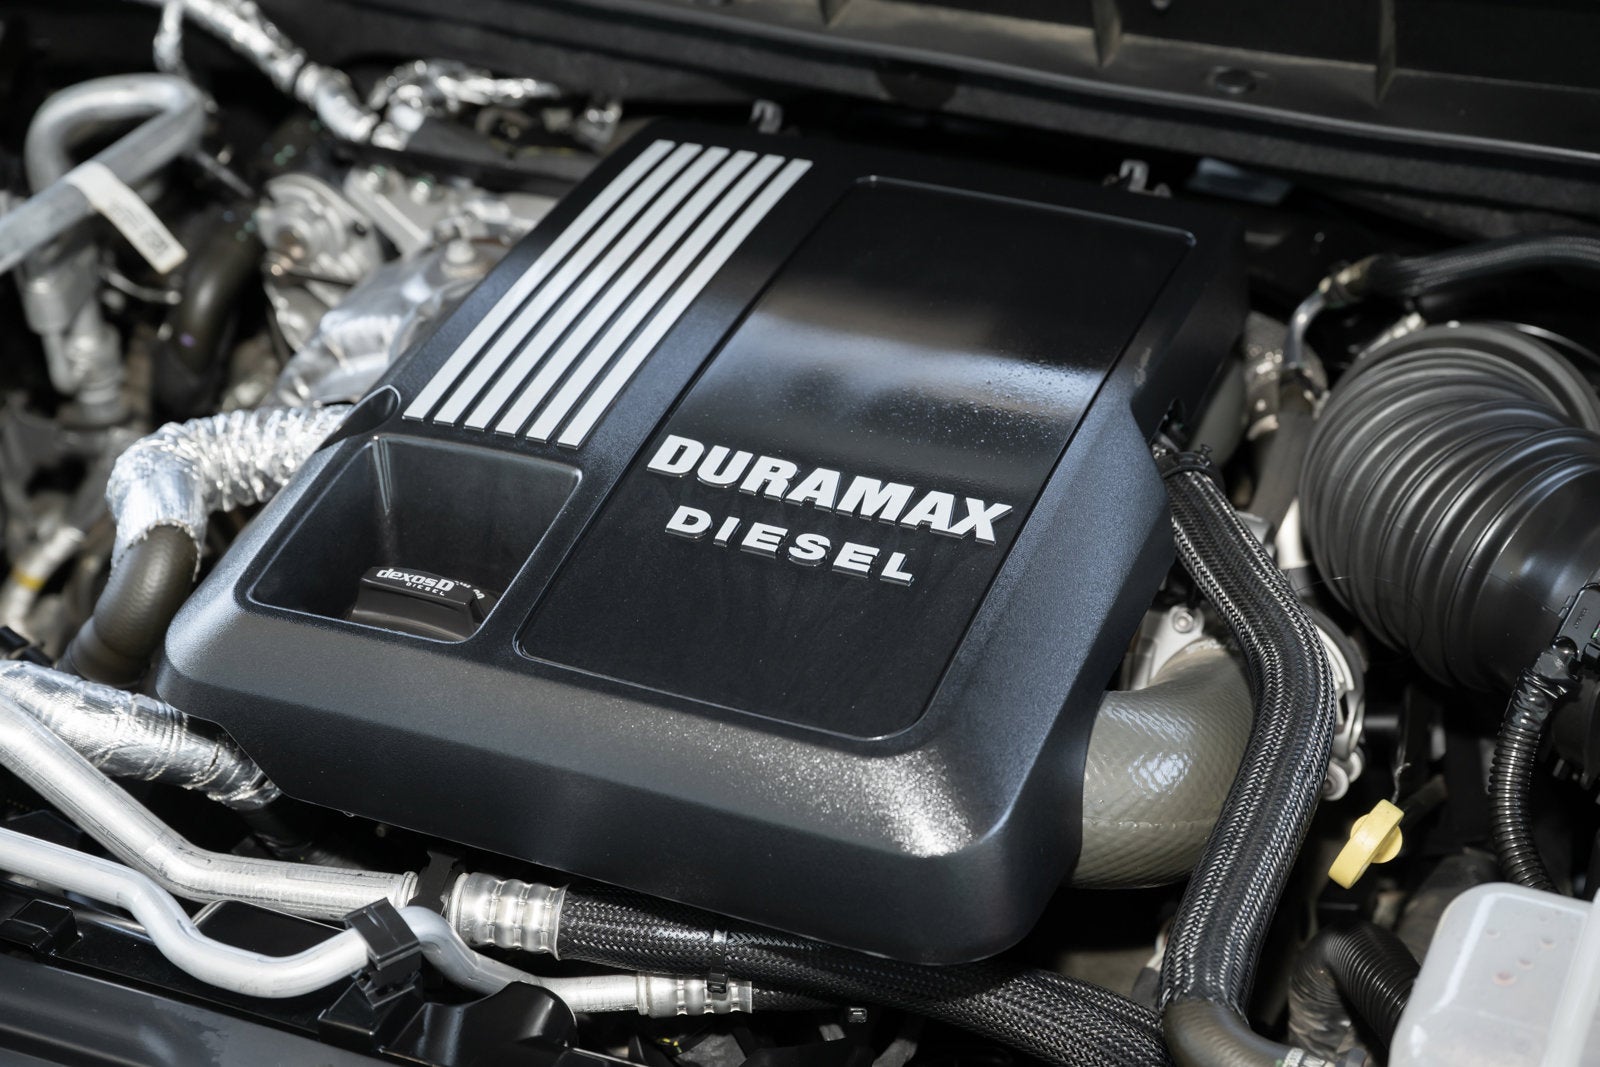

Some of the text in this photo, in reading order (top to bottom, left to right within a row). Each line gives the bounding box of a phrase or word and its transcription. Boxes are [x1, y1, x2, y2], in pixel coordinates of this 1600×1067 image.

[647, 434, 1012, 545] DURAMAX
[376, 568, 455, 591] dexosD
[665, 505, 914, 586] DIESEL
